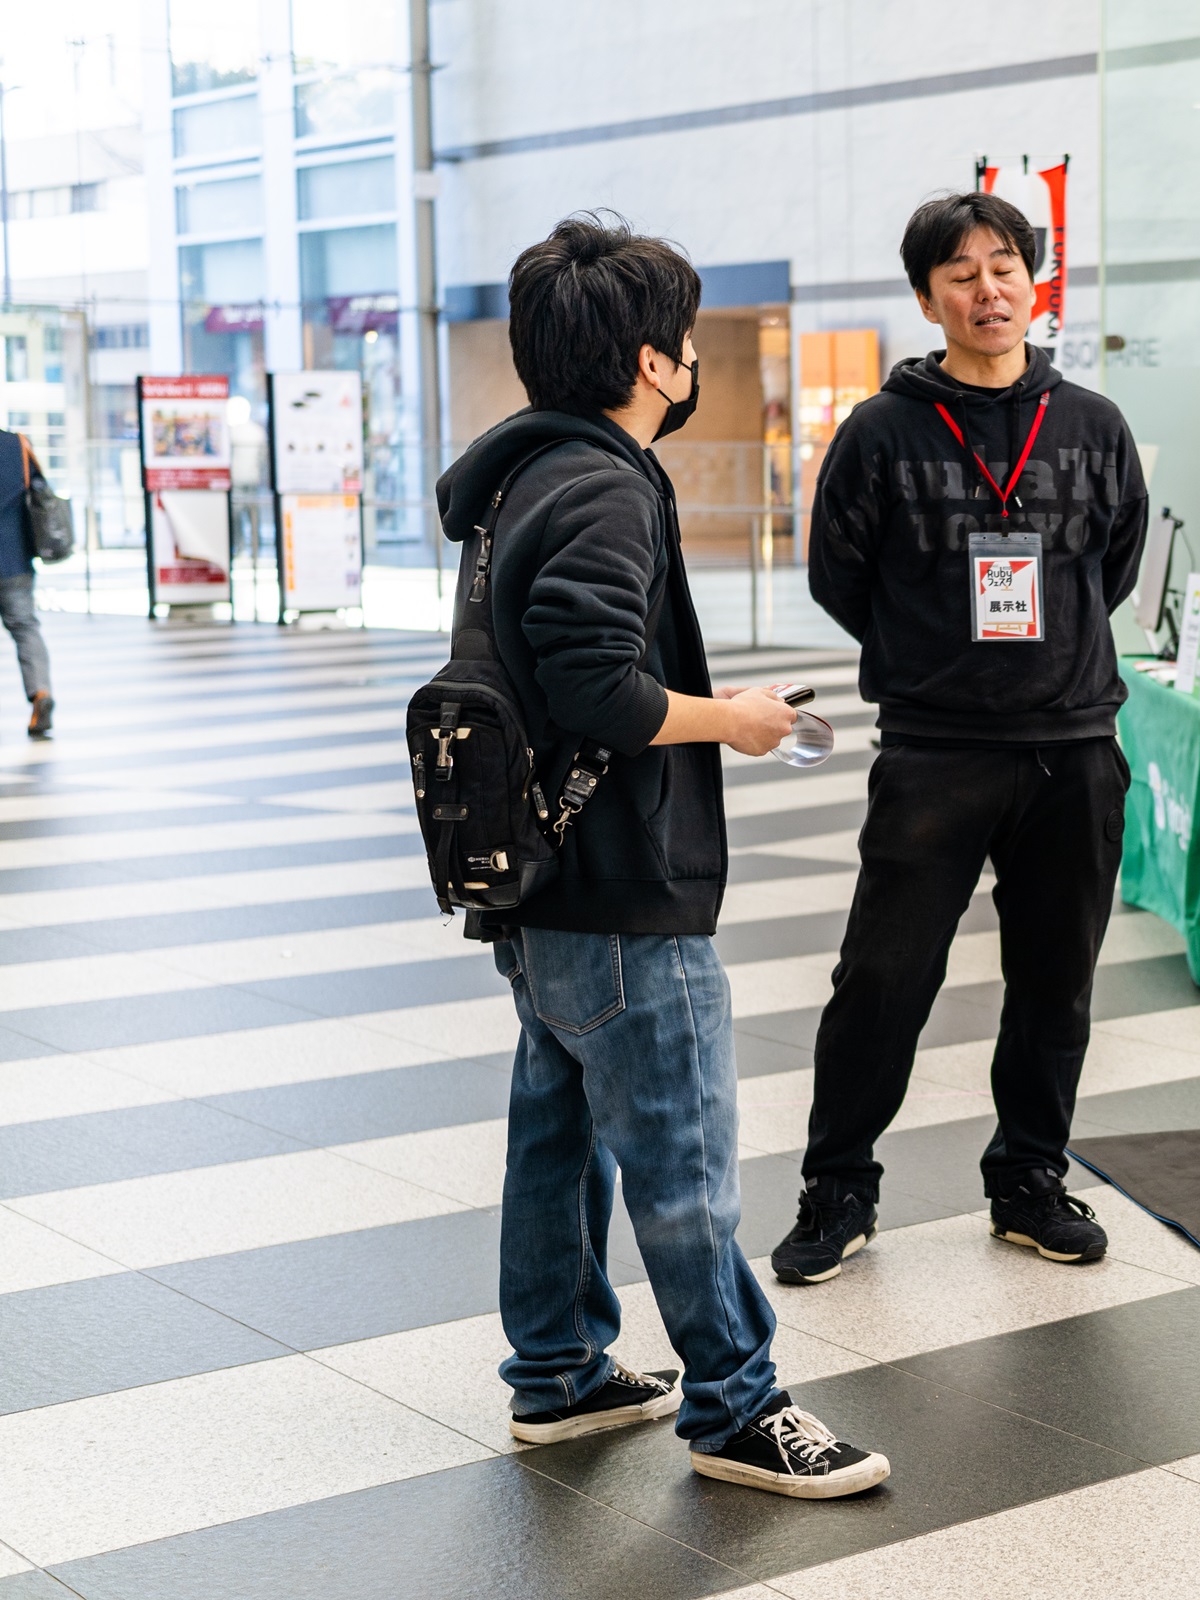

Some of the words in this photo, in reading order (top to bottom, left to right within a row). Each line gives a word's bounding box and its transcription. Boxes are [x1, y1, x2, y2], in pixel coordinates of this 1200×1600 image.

[987, 566, 1012, 578] Ruby
[987, 577, 1012, 587] フェスタ
[989, 600, 1027, 613] 展示社
